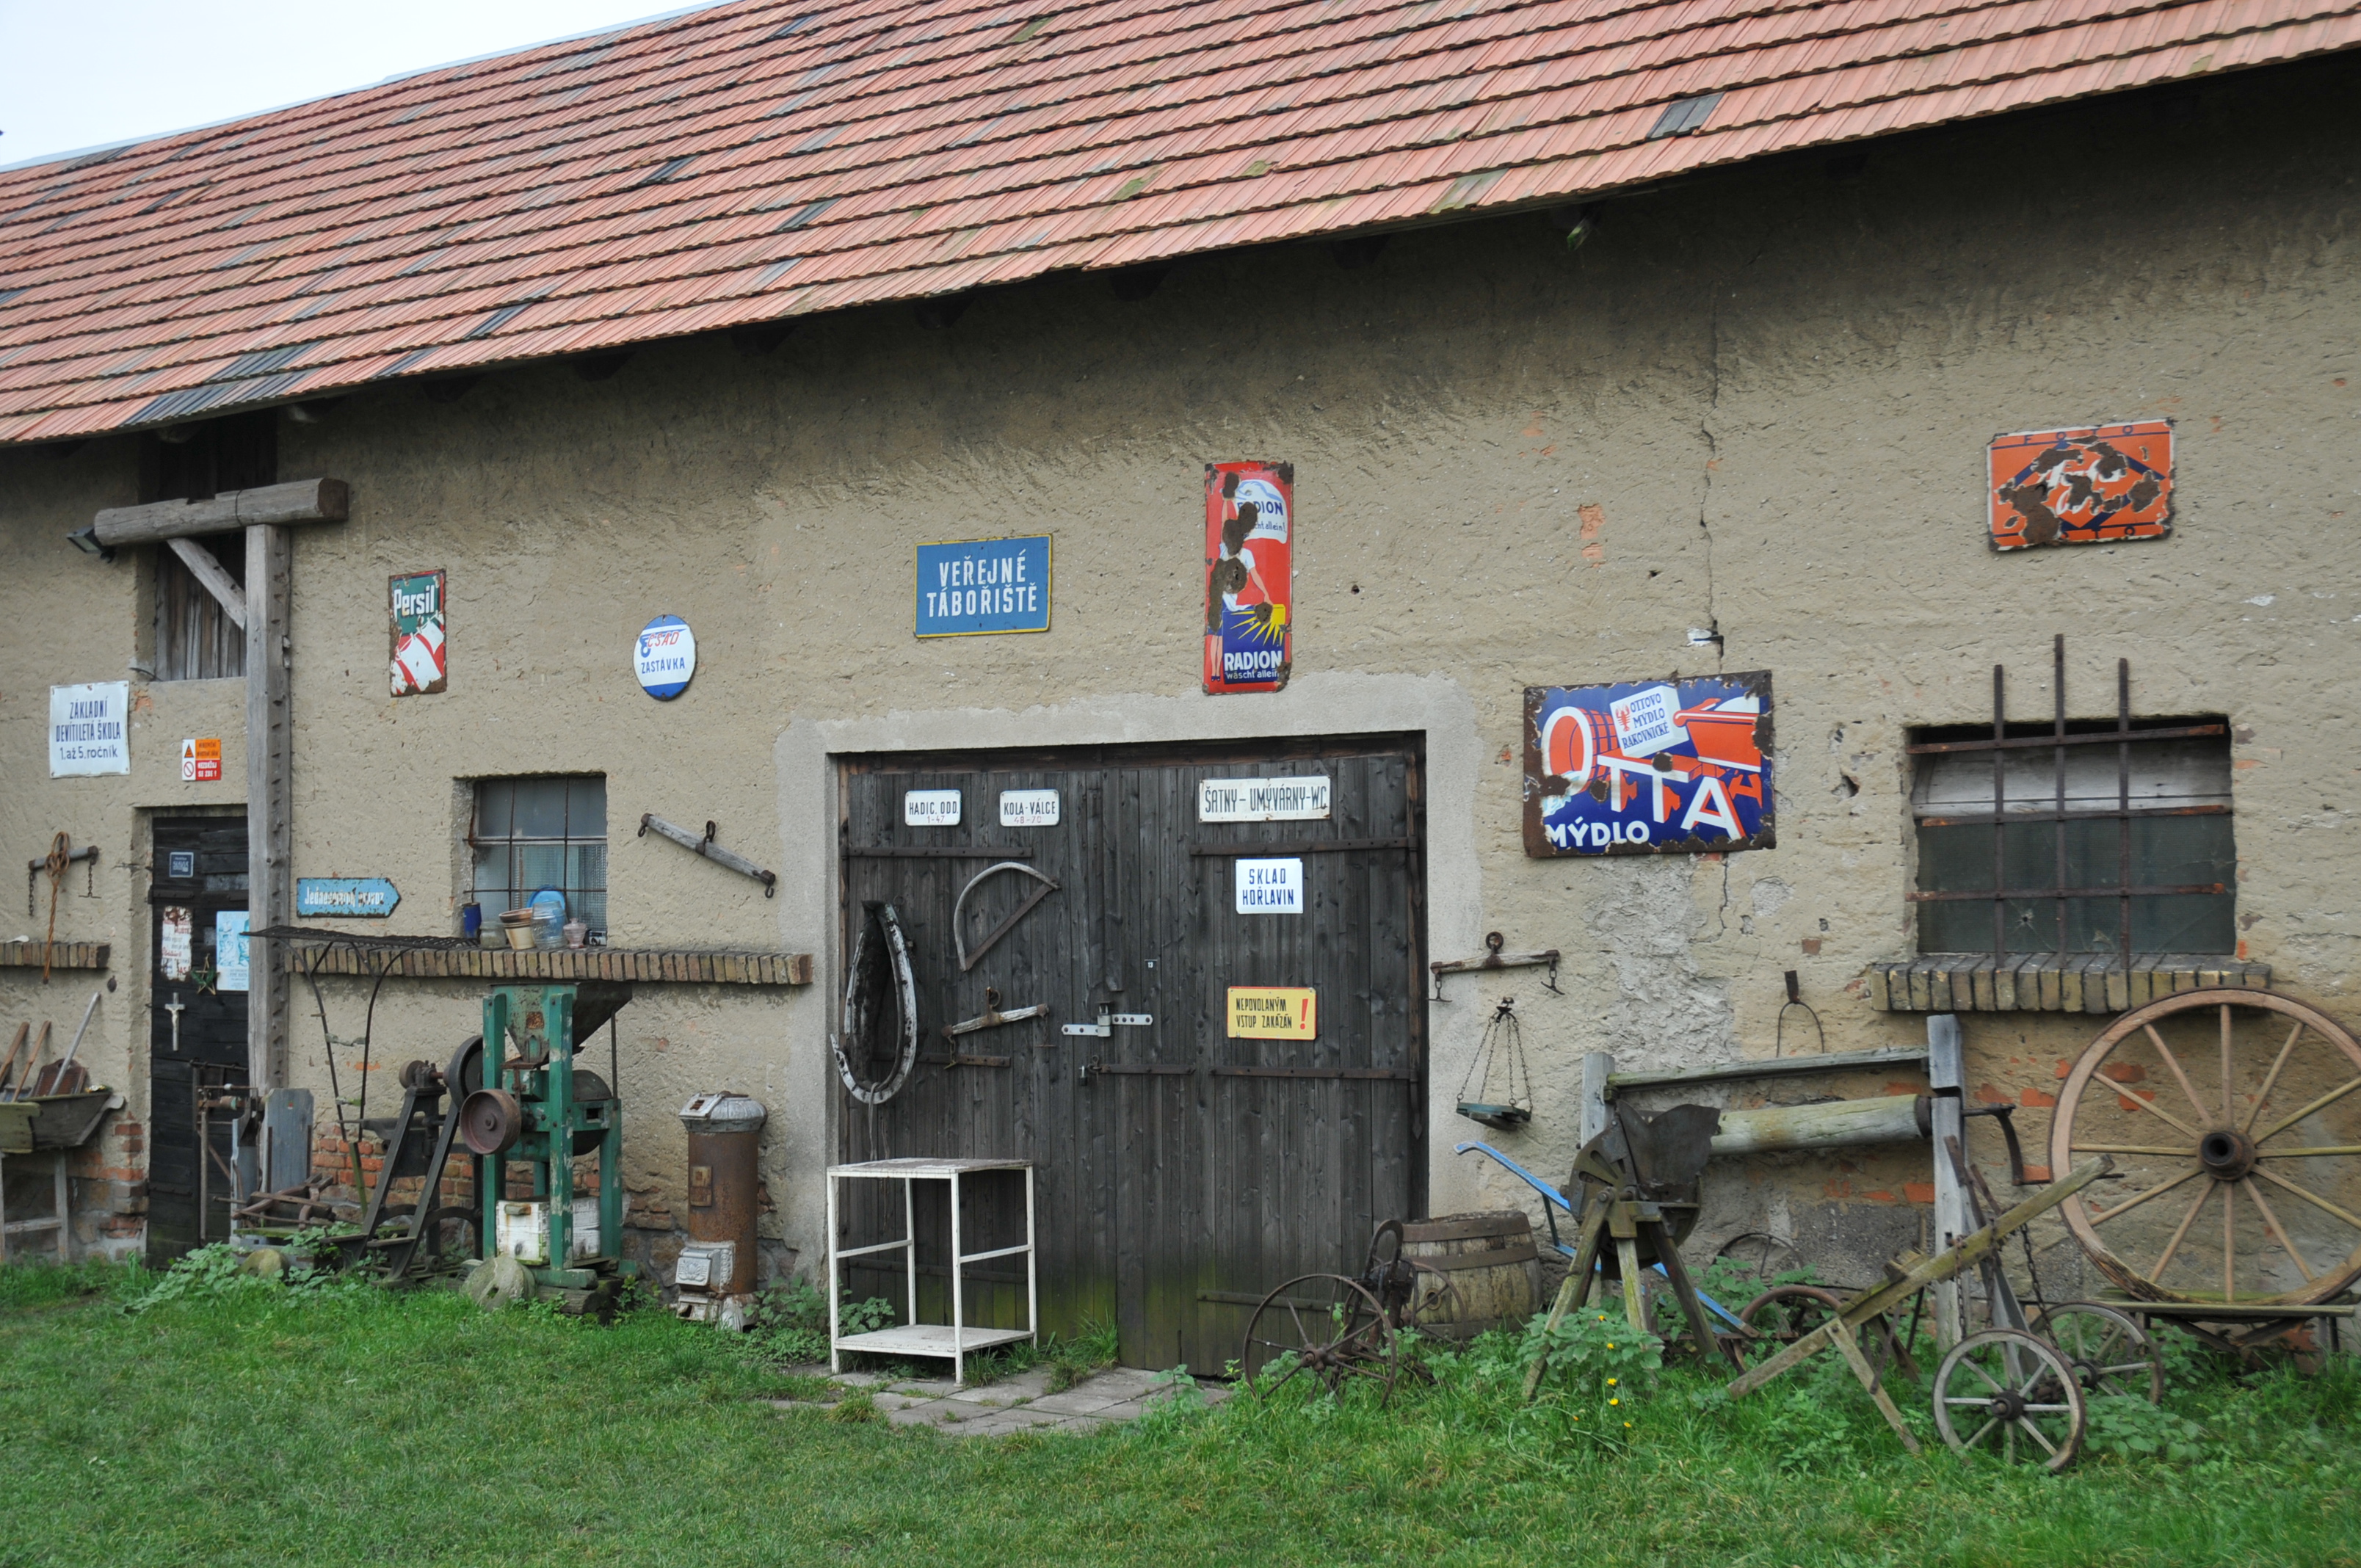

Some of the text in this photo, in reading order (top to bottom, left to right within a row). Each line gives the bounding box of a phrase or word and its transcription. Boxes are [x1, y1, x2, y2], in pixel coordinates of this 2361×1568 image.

[939, 549, 1026, 587] VEŘEJNÉ
[394, 584, 435, 622] Persil
[926, 582, 1037, 617] TÁBOŘIŠTĚ
[641, 657, 686, 674] ZASTÁVKA
[1224, 650, 1283, 671] RADION
[70, 696, 108, 719] ZÁKLADNÍ
[1630, 693, 1662, 713] OTTOVO
[1633, 708, 1666, 729] MÝDLO
[56, 719, 121, 743] DEVÍTILETÁ ŠKOLA
[1621, 720, 1670, 749] RAKOVNICKÉ
[1542, 705, 1747, 841] OTTA
[909, 801, 959, 815] HADIC. ODD.
[1205, 785, 1238, 813] ŠATNY
[1545, 816, 1650, 848] MÝDLO
[1249, 868, 1286, 885] SKLAD
[1242, 886, 1294, 906] HOŘLAVIN
[1236, 996, 1287, 1012] NEPOVOLANÝM
[1236, 1013, 1292, 1029] VSTUP ZAKÁZÁN
